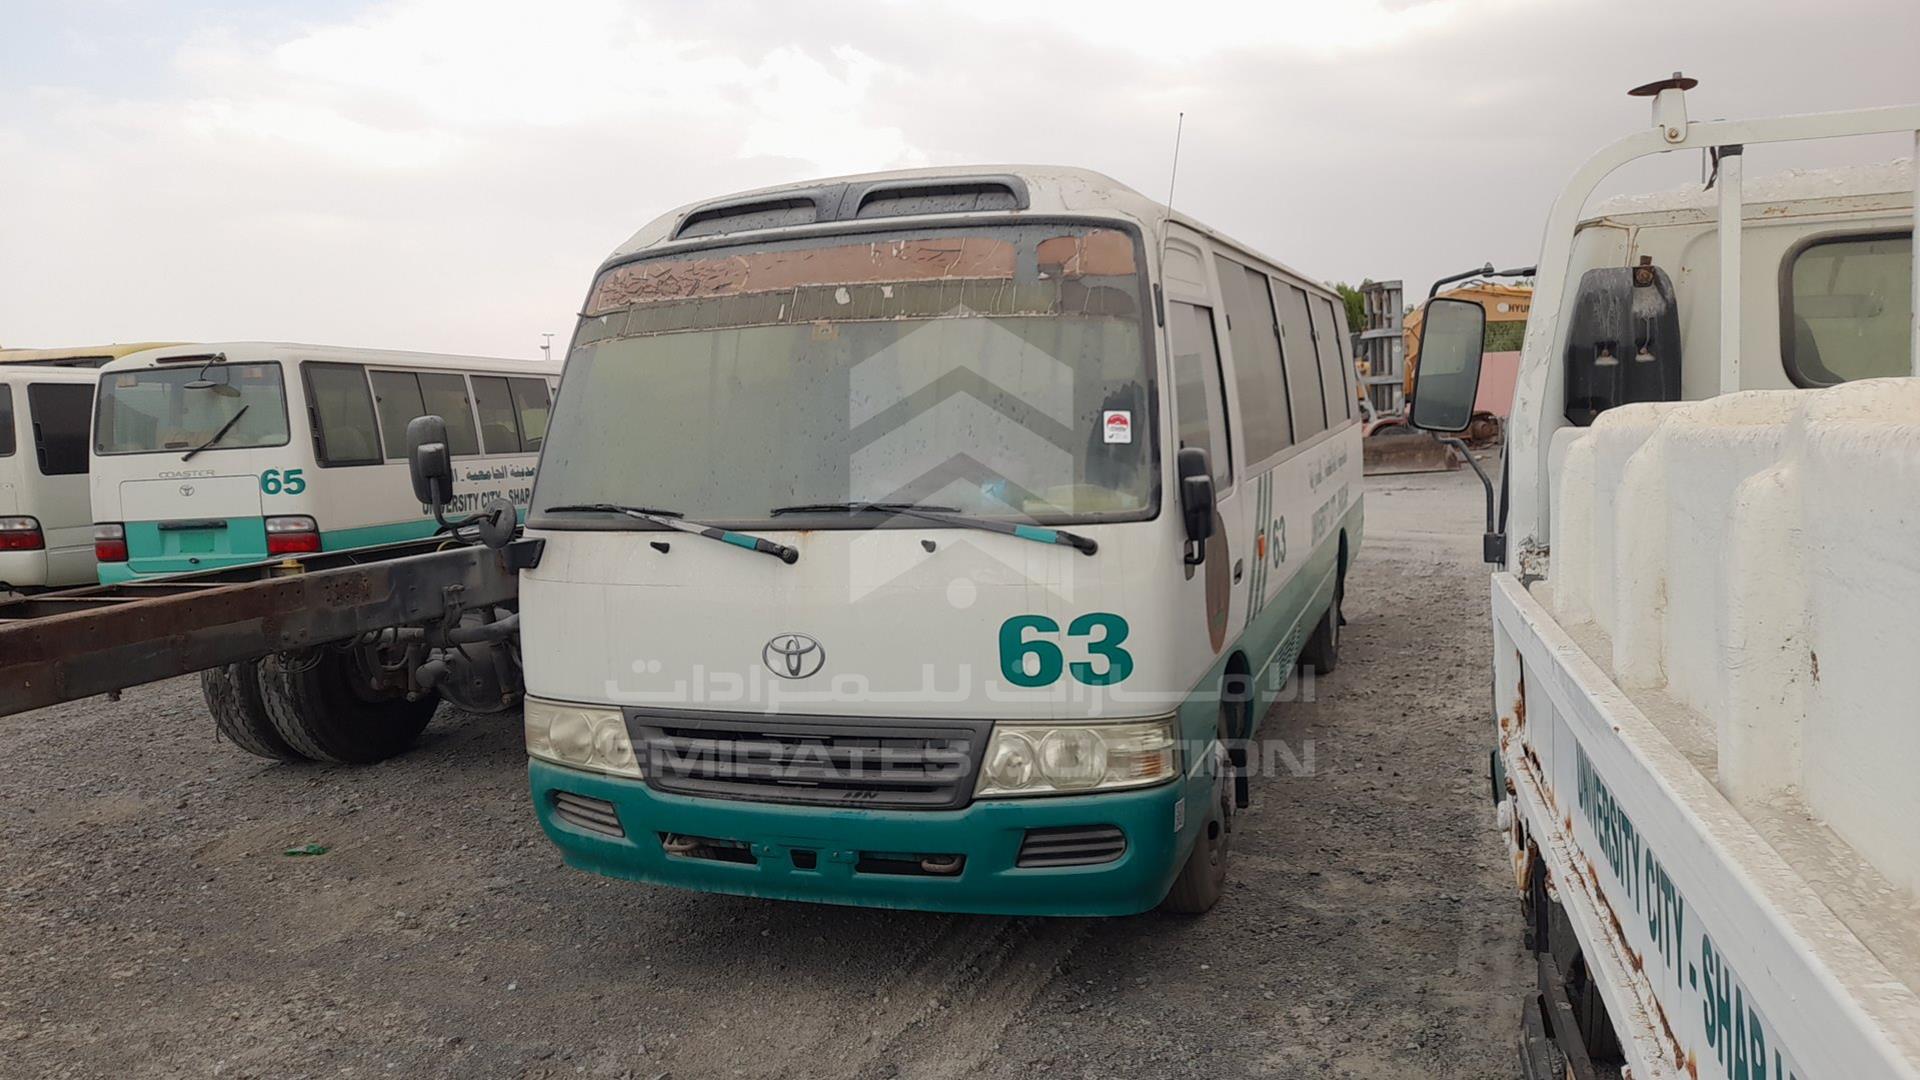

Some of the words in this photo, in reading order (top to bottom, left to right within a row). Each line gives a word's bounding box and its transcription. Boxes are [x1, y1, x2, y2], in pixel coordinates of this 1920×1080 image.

[158, 469, 215, 479] COASTER
[260, 468, 306, 495] 65
[422, 492, 480, 515] UERSITY
[1273, 515, 1287, 569] 63
[999, 612, 1134, 688] 63
[1575, 738, 1640, 914] UNIVERSITY
[1645, 847, 1683, 991] CITY
[1702, 933, 1798, 1080] SHAR
